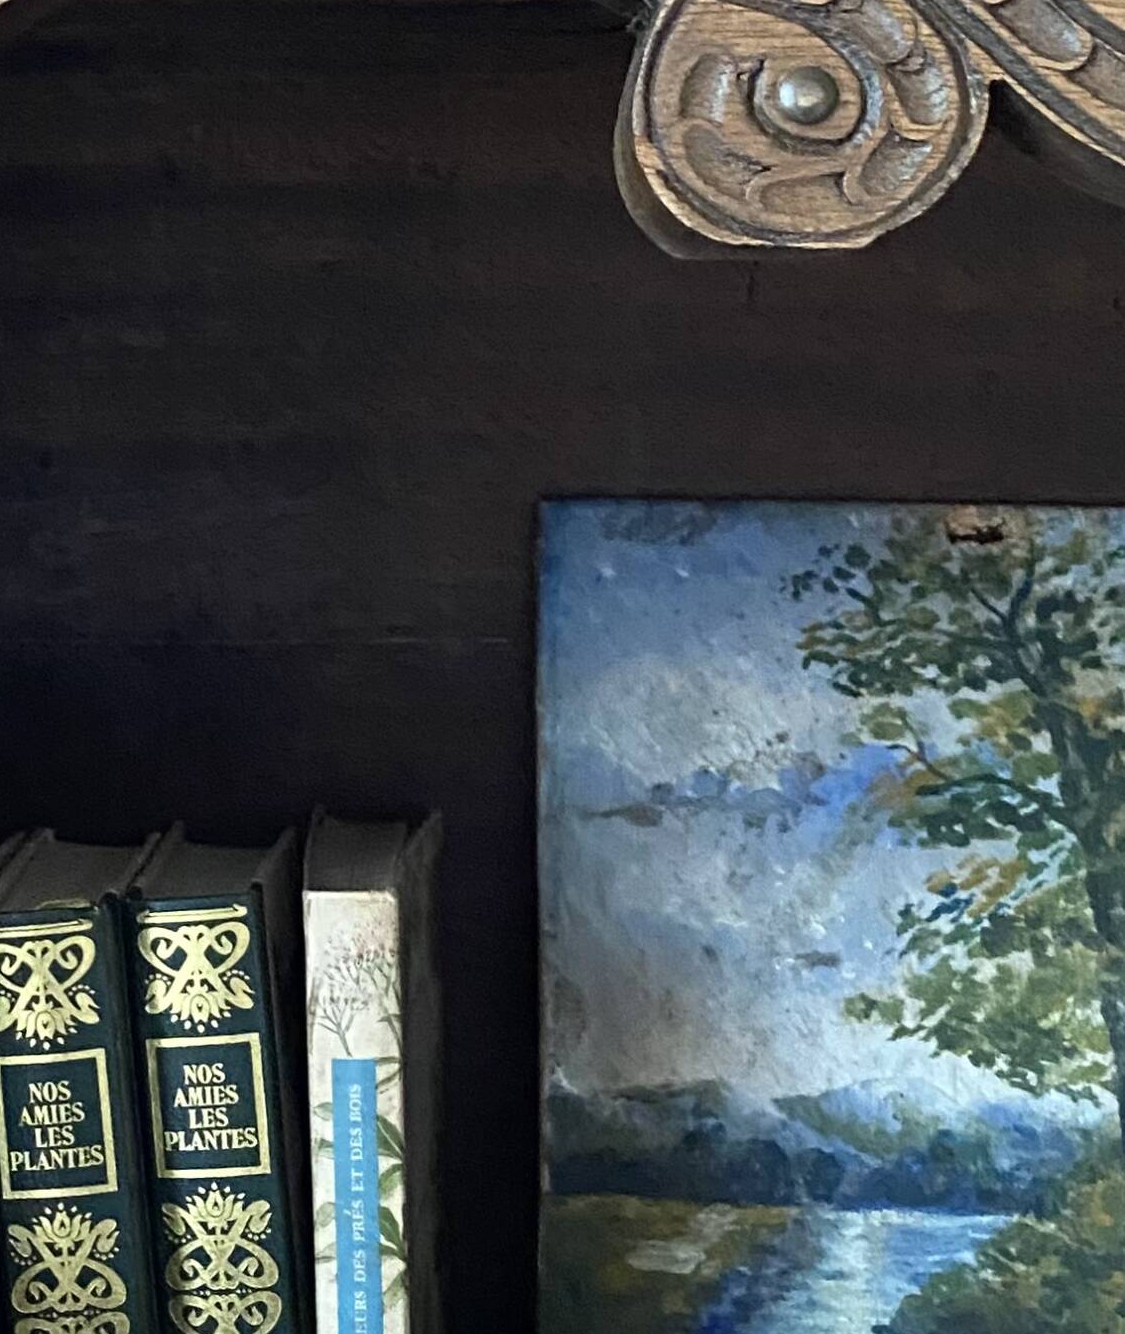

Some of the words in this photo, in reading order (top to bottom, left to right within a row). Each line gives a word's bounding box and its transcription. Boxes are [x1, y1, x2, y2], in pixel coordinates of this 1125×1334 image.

[182, 1062, 227, 1085] NOS
[28, 1080, 72, 1104] NOS
[173, 1084, 240, 1107] AMIES
[348, 1083, 363, 1122] BOIS
[18, 1102, 86, 1127] AMIES
[188, 1107, 229, 1129] LES
[34, 1125, 76, 1148] LES
[164, 1127, 258, 1152] PLANTES
[349, 1127, 363, 1161] DES
[10, 1145, 105, 1171] PLANTES
[350, 1168, 364, 1192] ET
[343, 1199, 365, 1242] PRÉS
[352, 1249, 367, 1283] DES
